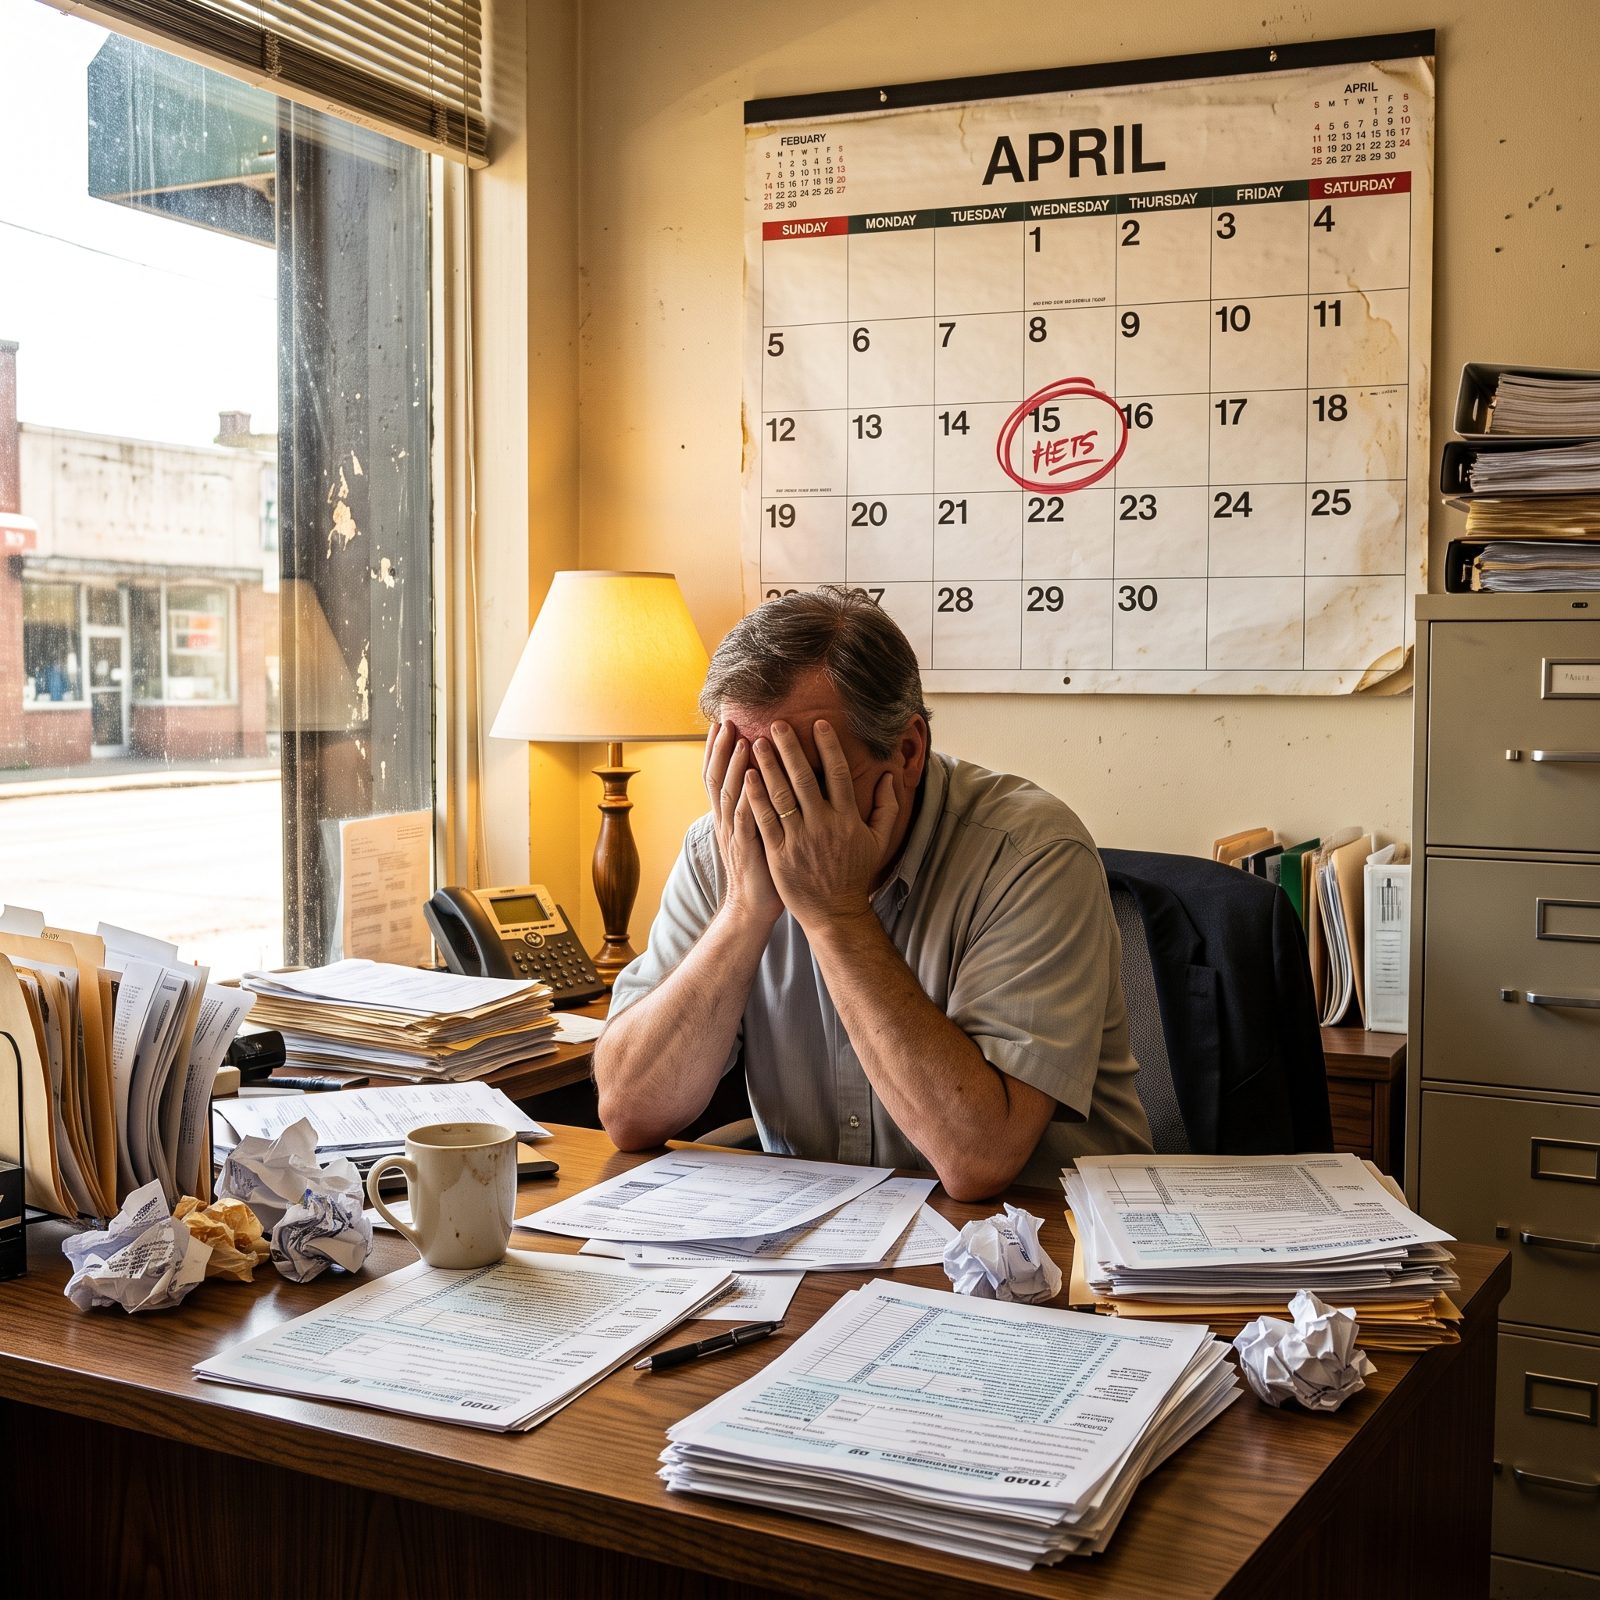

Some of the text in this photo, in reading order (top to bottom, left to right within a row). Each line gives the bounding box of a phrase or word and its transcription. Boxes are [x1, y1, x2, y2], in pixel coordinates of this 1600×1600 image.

[1344, 82, 1378, 93] APRIL
[1401, 116, 1410, 124] 10
[781, 134, 826, 146] FEBUARY
[1312, 146, 1322, 154] 18
[1370, 141, 1381, 149] 22
[1385, 140, 1395, 148] 23
[1400, 139, 1410, 147] 24
[1357, 131, 1366, 139] 14
[1371, 130, 1381, 138] 15
[982, 123, 1166, 185] APRIL
[1312, 157, 1322, 165] 25
[1326, 156, 1337, 164] 26
[1341, 155, 1351, 163] 27
[1356, 154, 1366, 162] 28
[782, 177, 1396, 235] SUNDAY MONDAY TUESDAY WEDNESDAY THURSDAY FRIDAY SATURDAY
[1030, 206, 1335, 252] 1 2 3 4
[768, 300, 1340, 356] 5 6 7 8 9 10 11
[766, 395, 1347, 441] 12 13 14 15 16 17 18
[766, 489, 1351, 528] 19 20 21 22 23 24 25
[938, 587, 973, 612] 28
[1027, 586, 1063, 612] 29
[1118, 585, 1157, 611] 30
